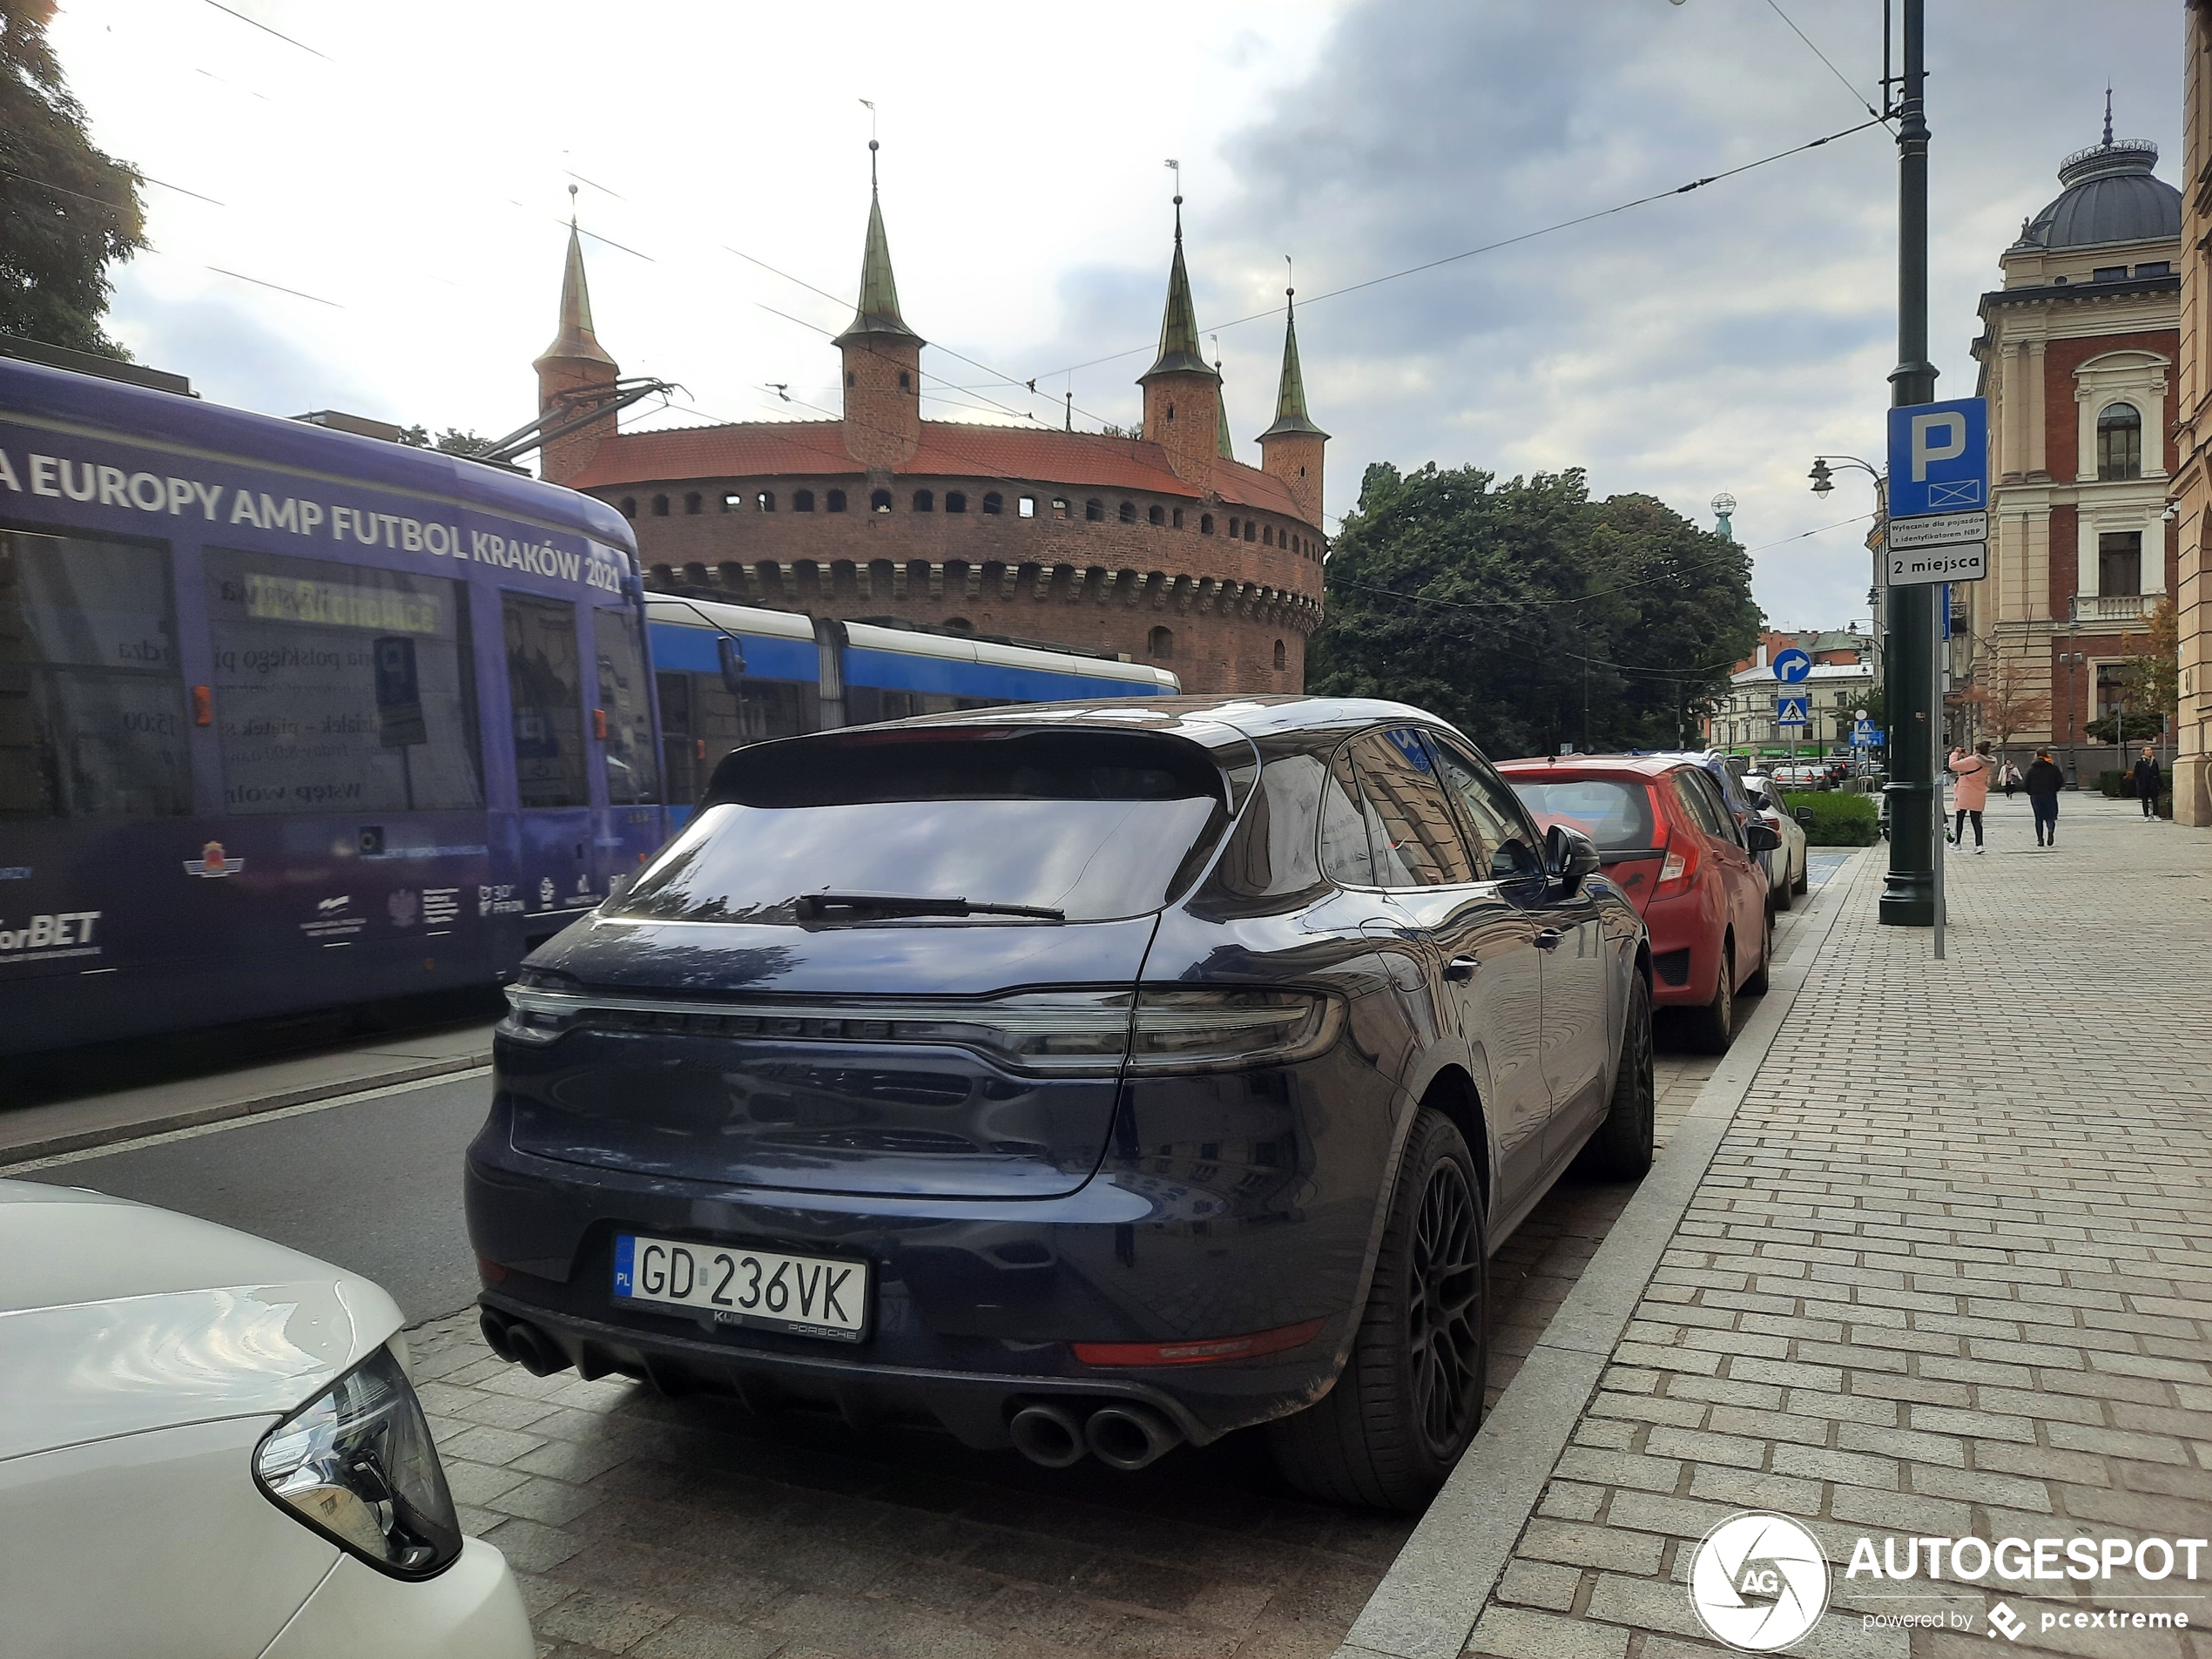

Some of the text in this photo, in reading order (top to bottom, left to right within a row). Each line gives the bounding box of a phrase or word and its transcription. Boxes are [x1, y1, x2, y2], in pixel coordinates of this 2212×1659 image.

[1912, 411, 1966, 482] P
[28, 452, 224, 522] EUROPY
[230, 489, 325, 536] AMP
[330, 504, 469, 560] FUTBOL
[470, 529, 581, 583] KRAKÓW
[583, 556, 622, 595] 2021
[1947, 516, 1986, 528] pojazdów
[1901, 531, 1961, 543] identyfikatorem
[1893, 556, 1980, 575] 2 miejsca
[0, 911, 102, 949] orBET
[617, 1272, 631, 1287] PL
[642, 1244, 852, 1322] GD 236VK
[788, 1323, 857, 1341] PORSCHE
